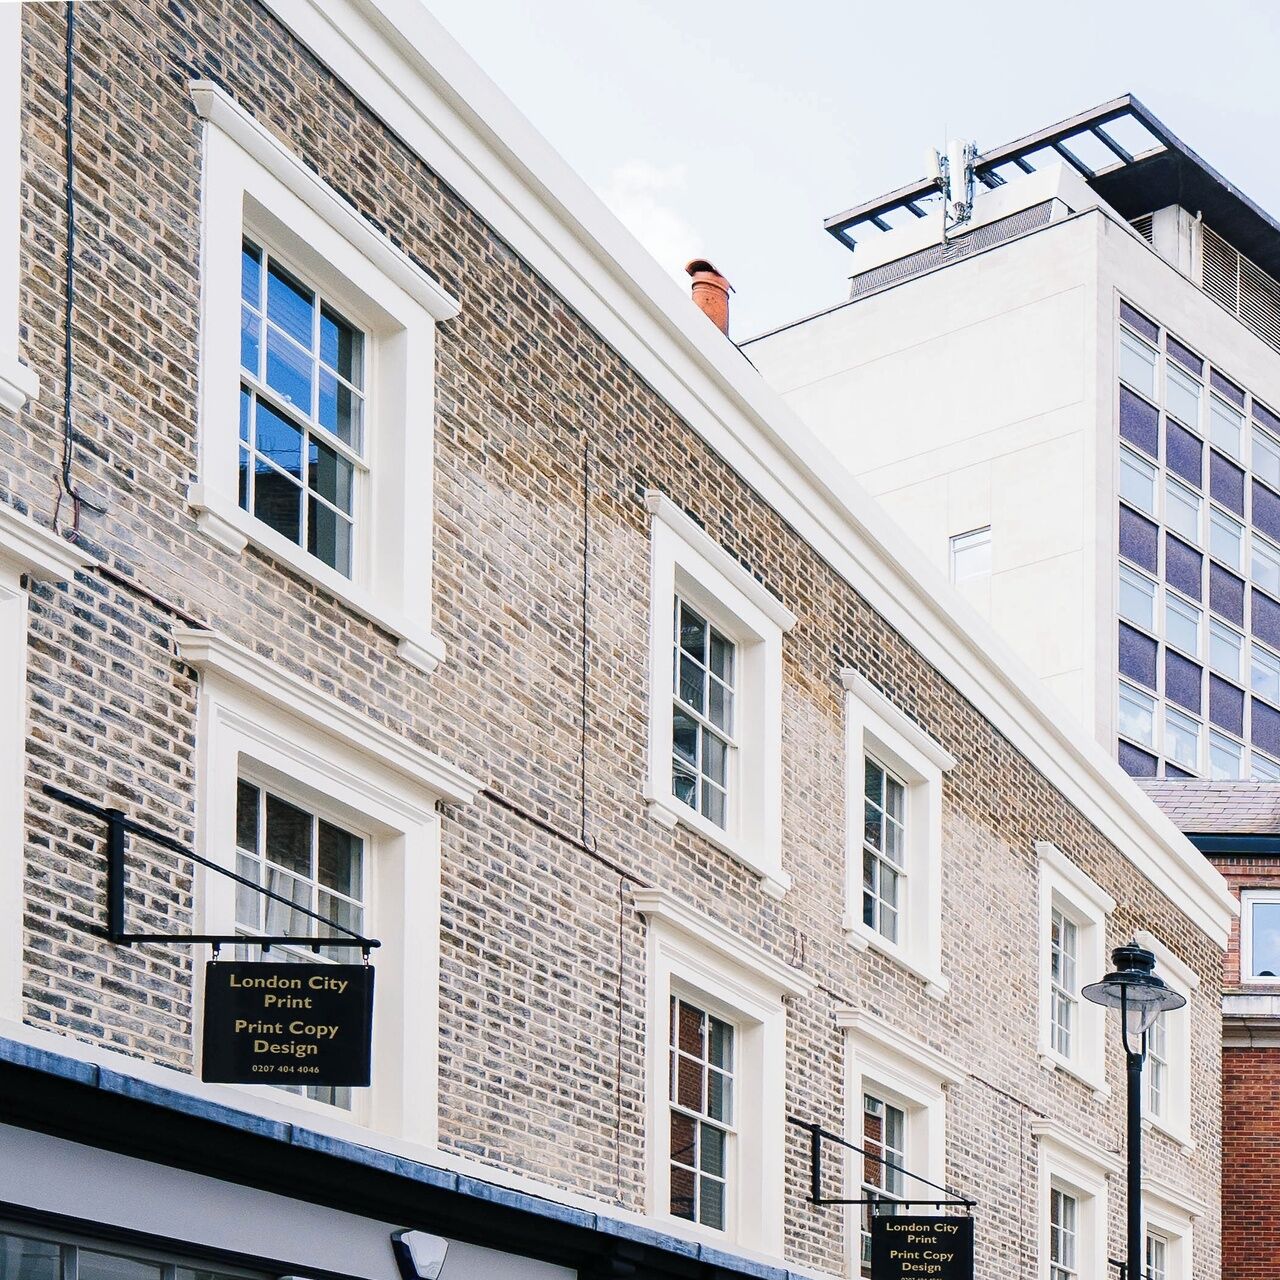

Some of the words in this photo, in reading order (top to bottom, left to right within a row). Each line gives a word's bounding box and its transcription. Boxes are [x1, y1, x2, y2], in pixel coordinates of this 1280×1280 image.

[230, 974, 302, 989] London
[308, 976, 348, 994] City
[264, 995, 313, 1009] Print
[235, 1020, 283, 1034] Print
[289, 1021, 339, 1039] Copy
[254, 1040, 318, 1058] Design
[252, 1065, 275, 1073] 0207
[277, 1065, 295, 1073] 404
[297, 1066, 320, 1074] 4046
[886, 1222, 930, 1232] London
[934, 1223, 959, 1234] City
[907, 1235, 937, 1244] Print
[890, 1250, 920, 1259] Print
[923, 1251, 954, 1262] Copy
[902, 1262, 942, 1273] Design
